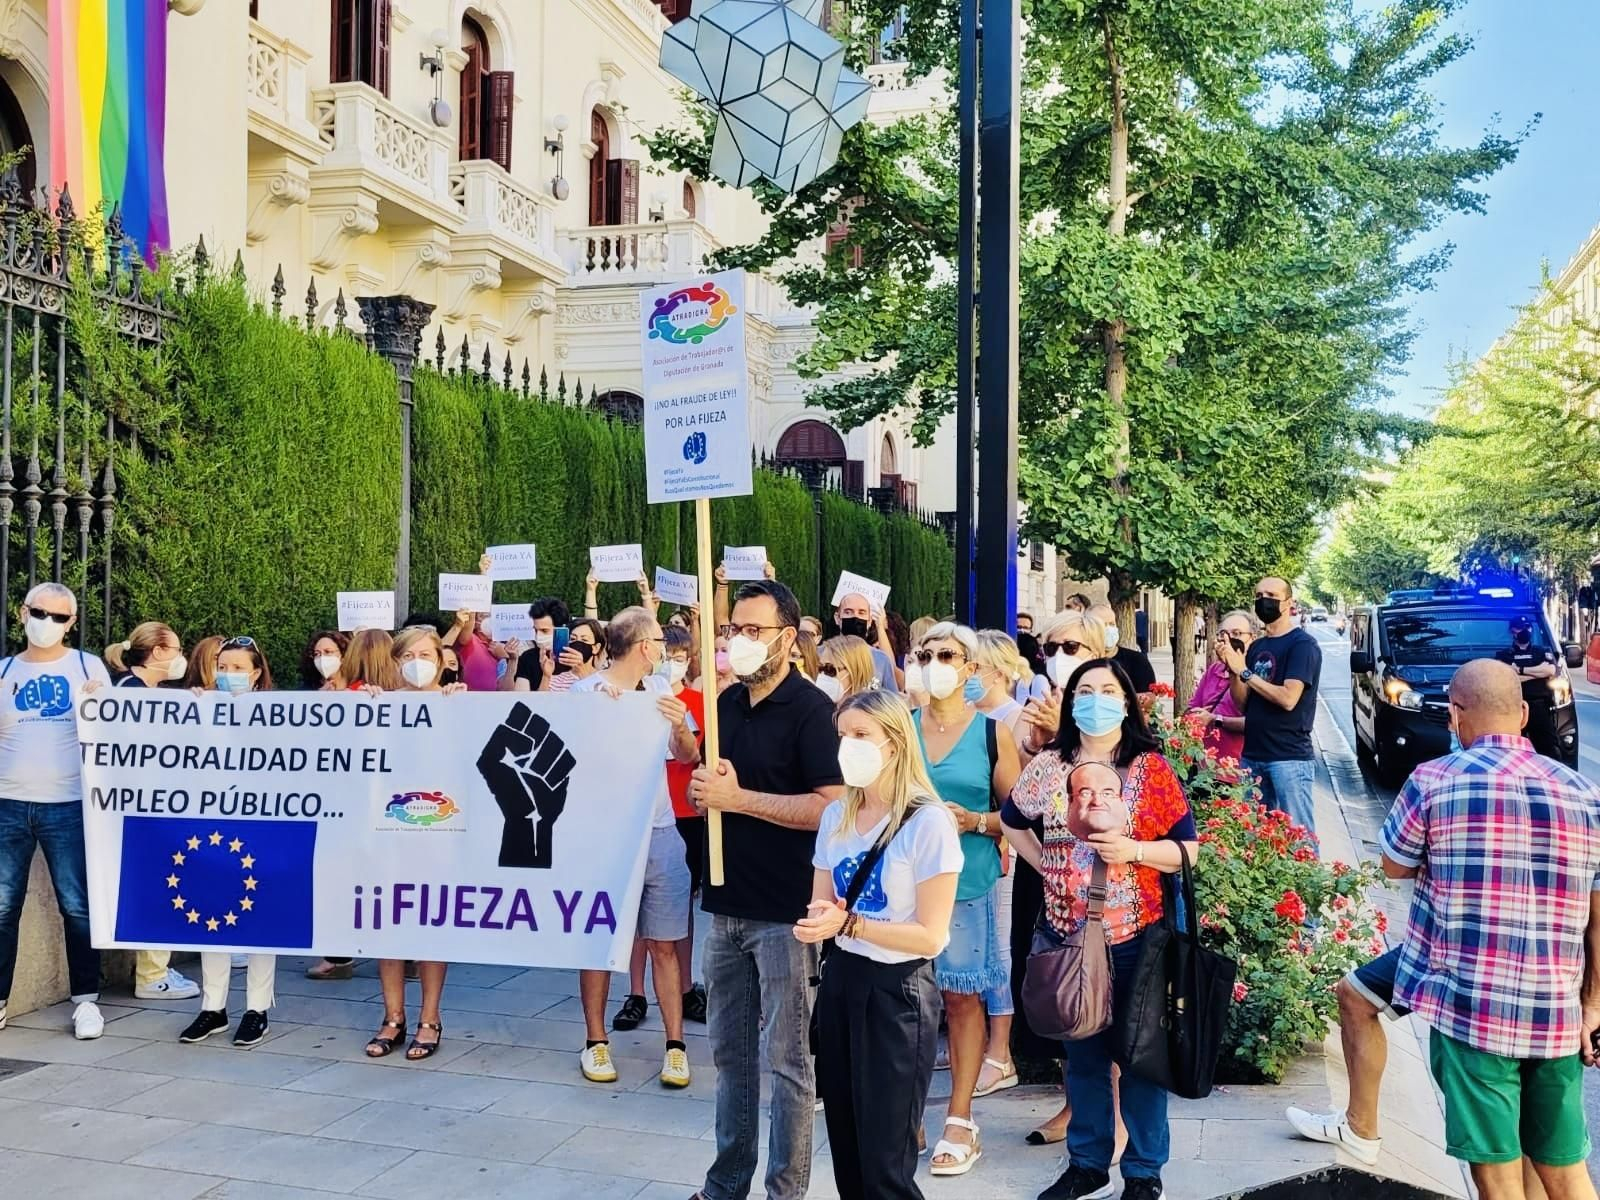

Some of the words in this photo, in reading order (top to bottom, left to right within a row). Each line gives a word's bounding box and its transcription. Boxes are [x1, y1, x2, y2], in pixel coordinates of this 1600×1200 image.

[700, 360, 724, 371] Granada
[670, 399, 679, 407] AL
[680, 393, 707, 405] FRAUDE
[708, 392, 718, 401] DE
[665, 416, 683, 430] POR
[685, 414, 696, 426] LA
[698, 410, 727, 425] FIJEZA
[520, 551, 532, 560] YA
[594, 554, 624, 564] #Fijeza
[626, 552, 639, 561] YA
[443, 582, 473, 592] #Fijeza
[476, 583, 489, 592] YA
[682, 581, 695, 590] YA
[341, 600, 374, 610] #Fijeza
[377, 600, 391, 608] YA
[495, 612, 525, 624] #Fijeza
[80, 698, 201, 725] CONTRA
[212, 703, 241, 726] EL
[248, 703, 345, 727] ABUSO
[354, 703, 391, 728] DE
[401, 703, 433, 728] LA
[79, 741, 308, 772] TEMPORALIDAD
[316, 748, 352, 772] EN
[361, 748, 393, 773] EL
[90, 786, 190, 814] MPLEO
[199, 784, 344, 818] PÚBLICO...
[552, 889, 617, 935] YA
